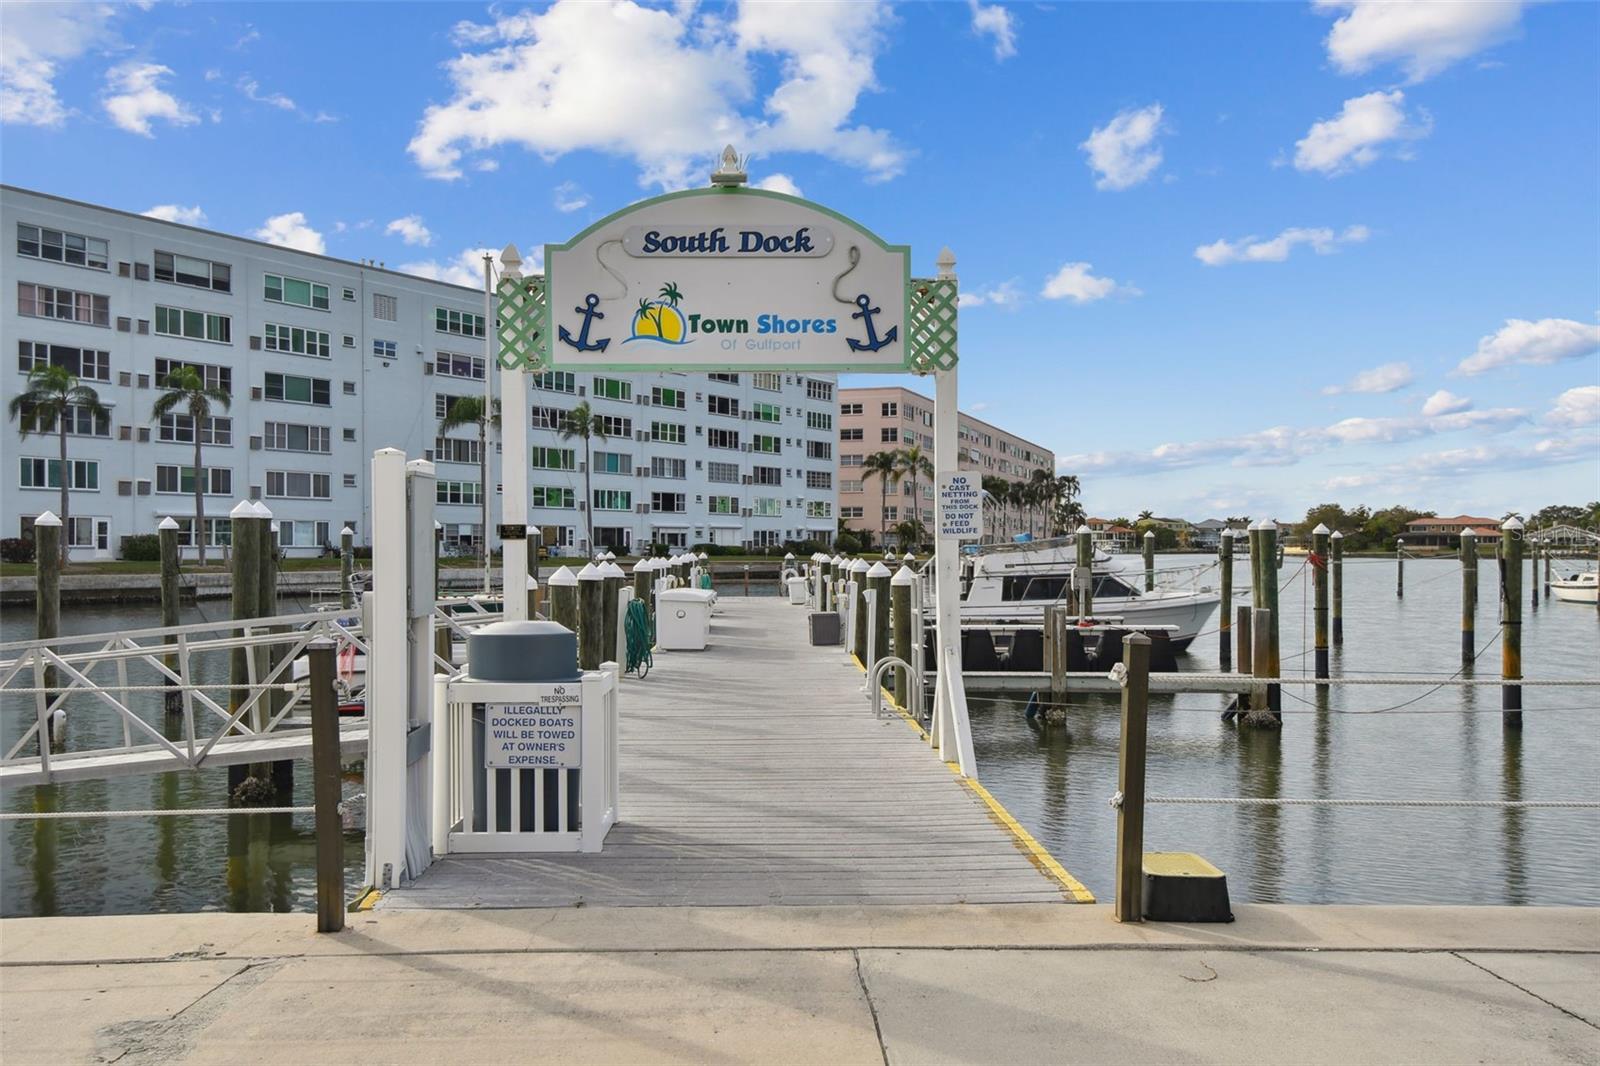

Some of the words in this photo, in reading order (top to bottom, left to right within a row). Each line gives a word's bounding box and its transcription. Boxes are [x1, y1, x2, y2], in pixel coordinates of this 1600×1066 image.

[642, 227, 730, 253] South
[737, 227, 814, 253] Dock
[688, 313, 749, 334] Town
[756, 314, 837, 334] Shores
[720, 339, 737, 350] Of
[744, 338, 801, 352] Gulfport
[554, 687, 565, 695] NO
[541, 695, 579, 703] TRESPASSING
[492, 718, 536, 727] DOCKED
[539, 718, 574, 727] BOATS
[521, 731, 535, 739] BE
[538, 731, 575, 739] TOWED
[518, 743, 565, 751] OWNER'S
